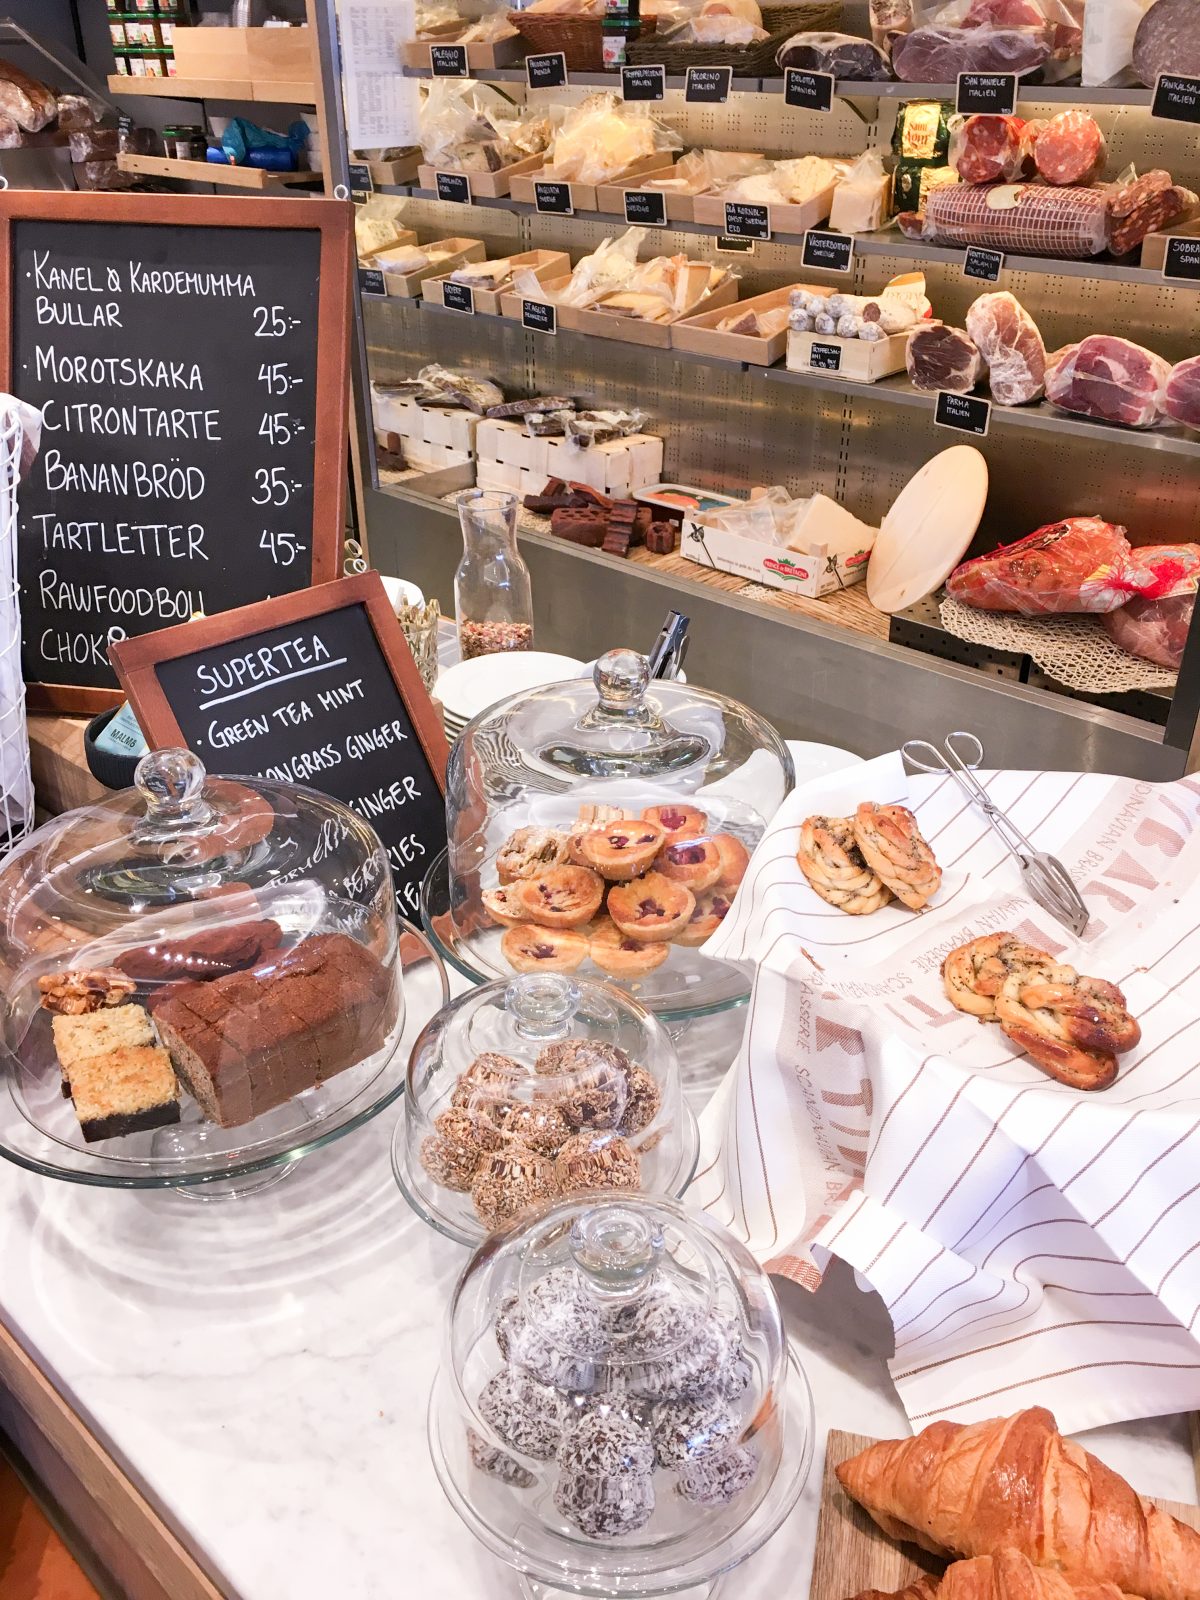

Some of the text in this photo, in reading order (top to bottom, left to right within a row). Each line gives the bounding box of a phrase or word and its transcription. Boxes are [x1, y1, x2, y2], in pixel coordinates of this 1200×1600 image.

[690, 69, 721, 80] PECORINO
[691, 82, 716, 90] ITALIEN
[964, 76, 979, 86] SAN
[968, 89, 997, 98] ITALIEN
[1167, 92, 1196, 105] ITALIEN
[33, 250, 103, 292] KANEL
[130, 260, 256, 297] KARDEMUMMA
[36, 295, 123, 328] BULLAR
[35, 345, 203, 391] MOROTSKAKA
[41, 400, 222, 441] CITRONTARTE
[946, 406, 970, 417] ITALIEN
[45, 449, 205, 501] BANANBRÖD
[32, 513, 209, 560] TARTLETTER
[40, 628, 113, 666] CHOK
[196, 634, 331, 695] SUPERTEA
[207, 678, 367, 750] GREEN TEA MINT
[346, 720, 408, 761] GINGER
